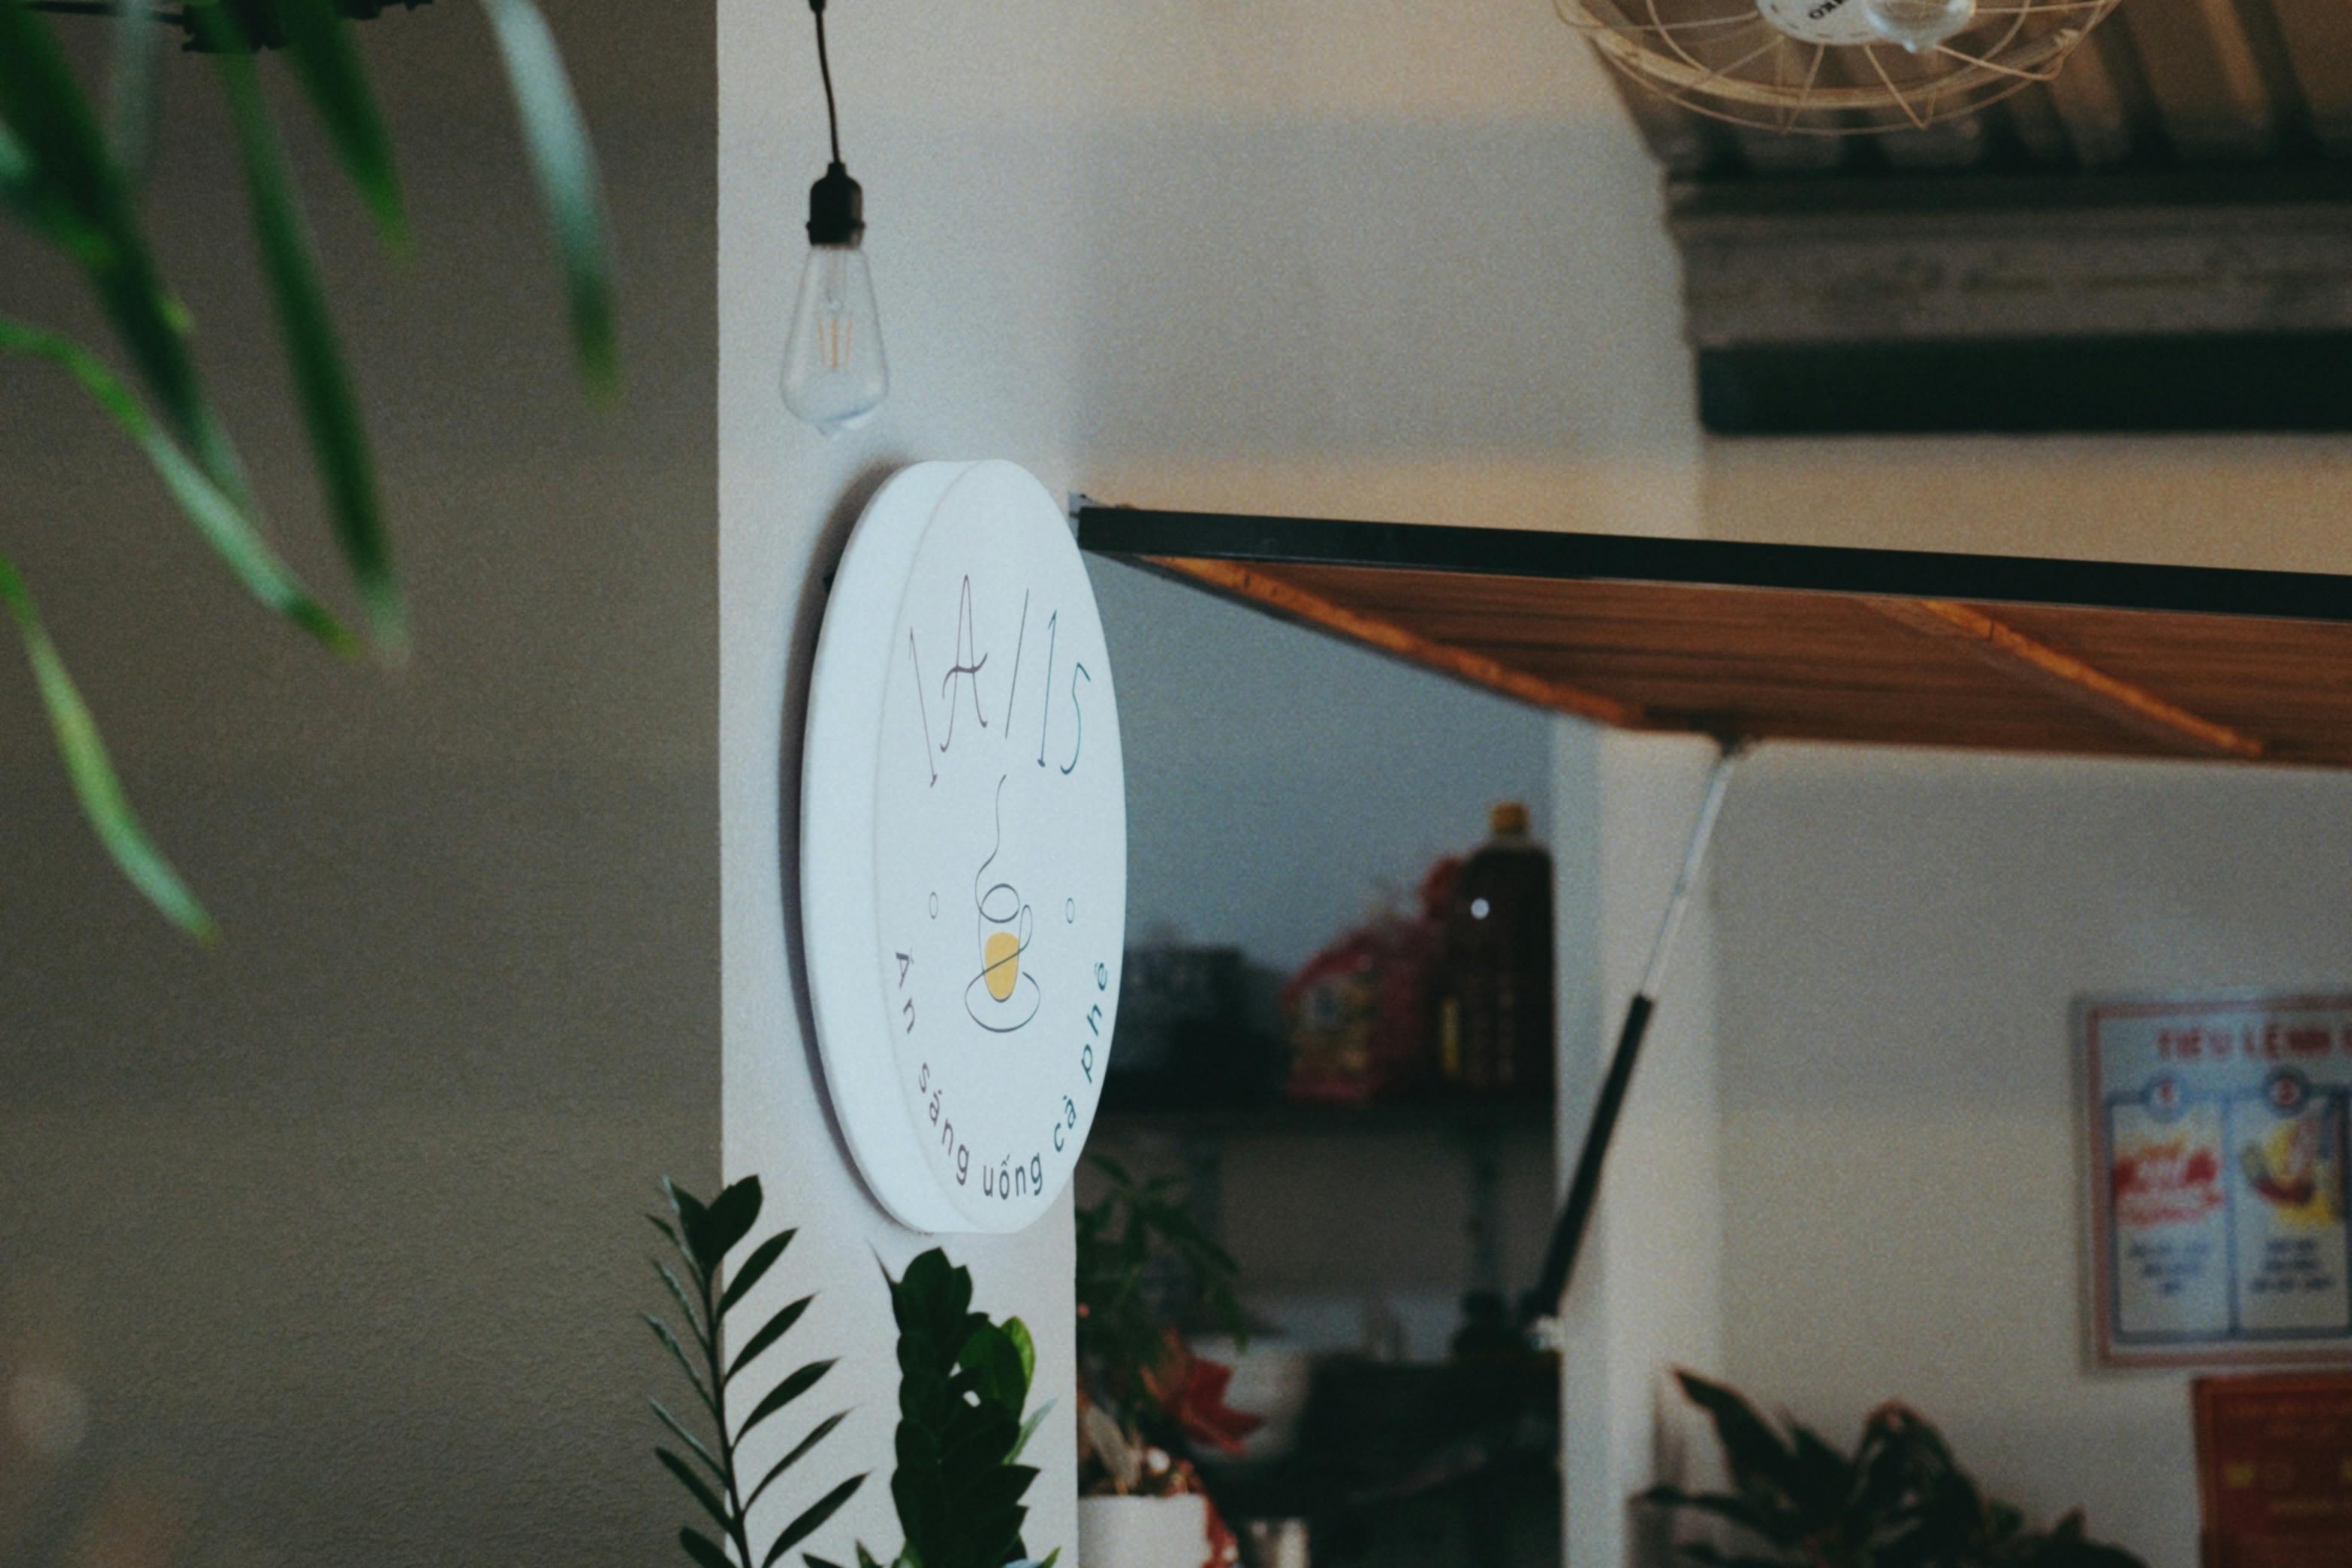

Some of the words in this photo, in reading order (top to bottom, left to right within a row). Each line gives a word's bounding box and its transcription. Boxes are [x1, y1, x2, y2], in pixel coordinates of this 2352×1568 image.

[918, 1061, 970, 1187] sáng
[982, 1153, 1043, 1200] uống
[1053, 1095, 1077, 1153] cà
[1080, 961, 1109, 1084] phê
